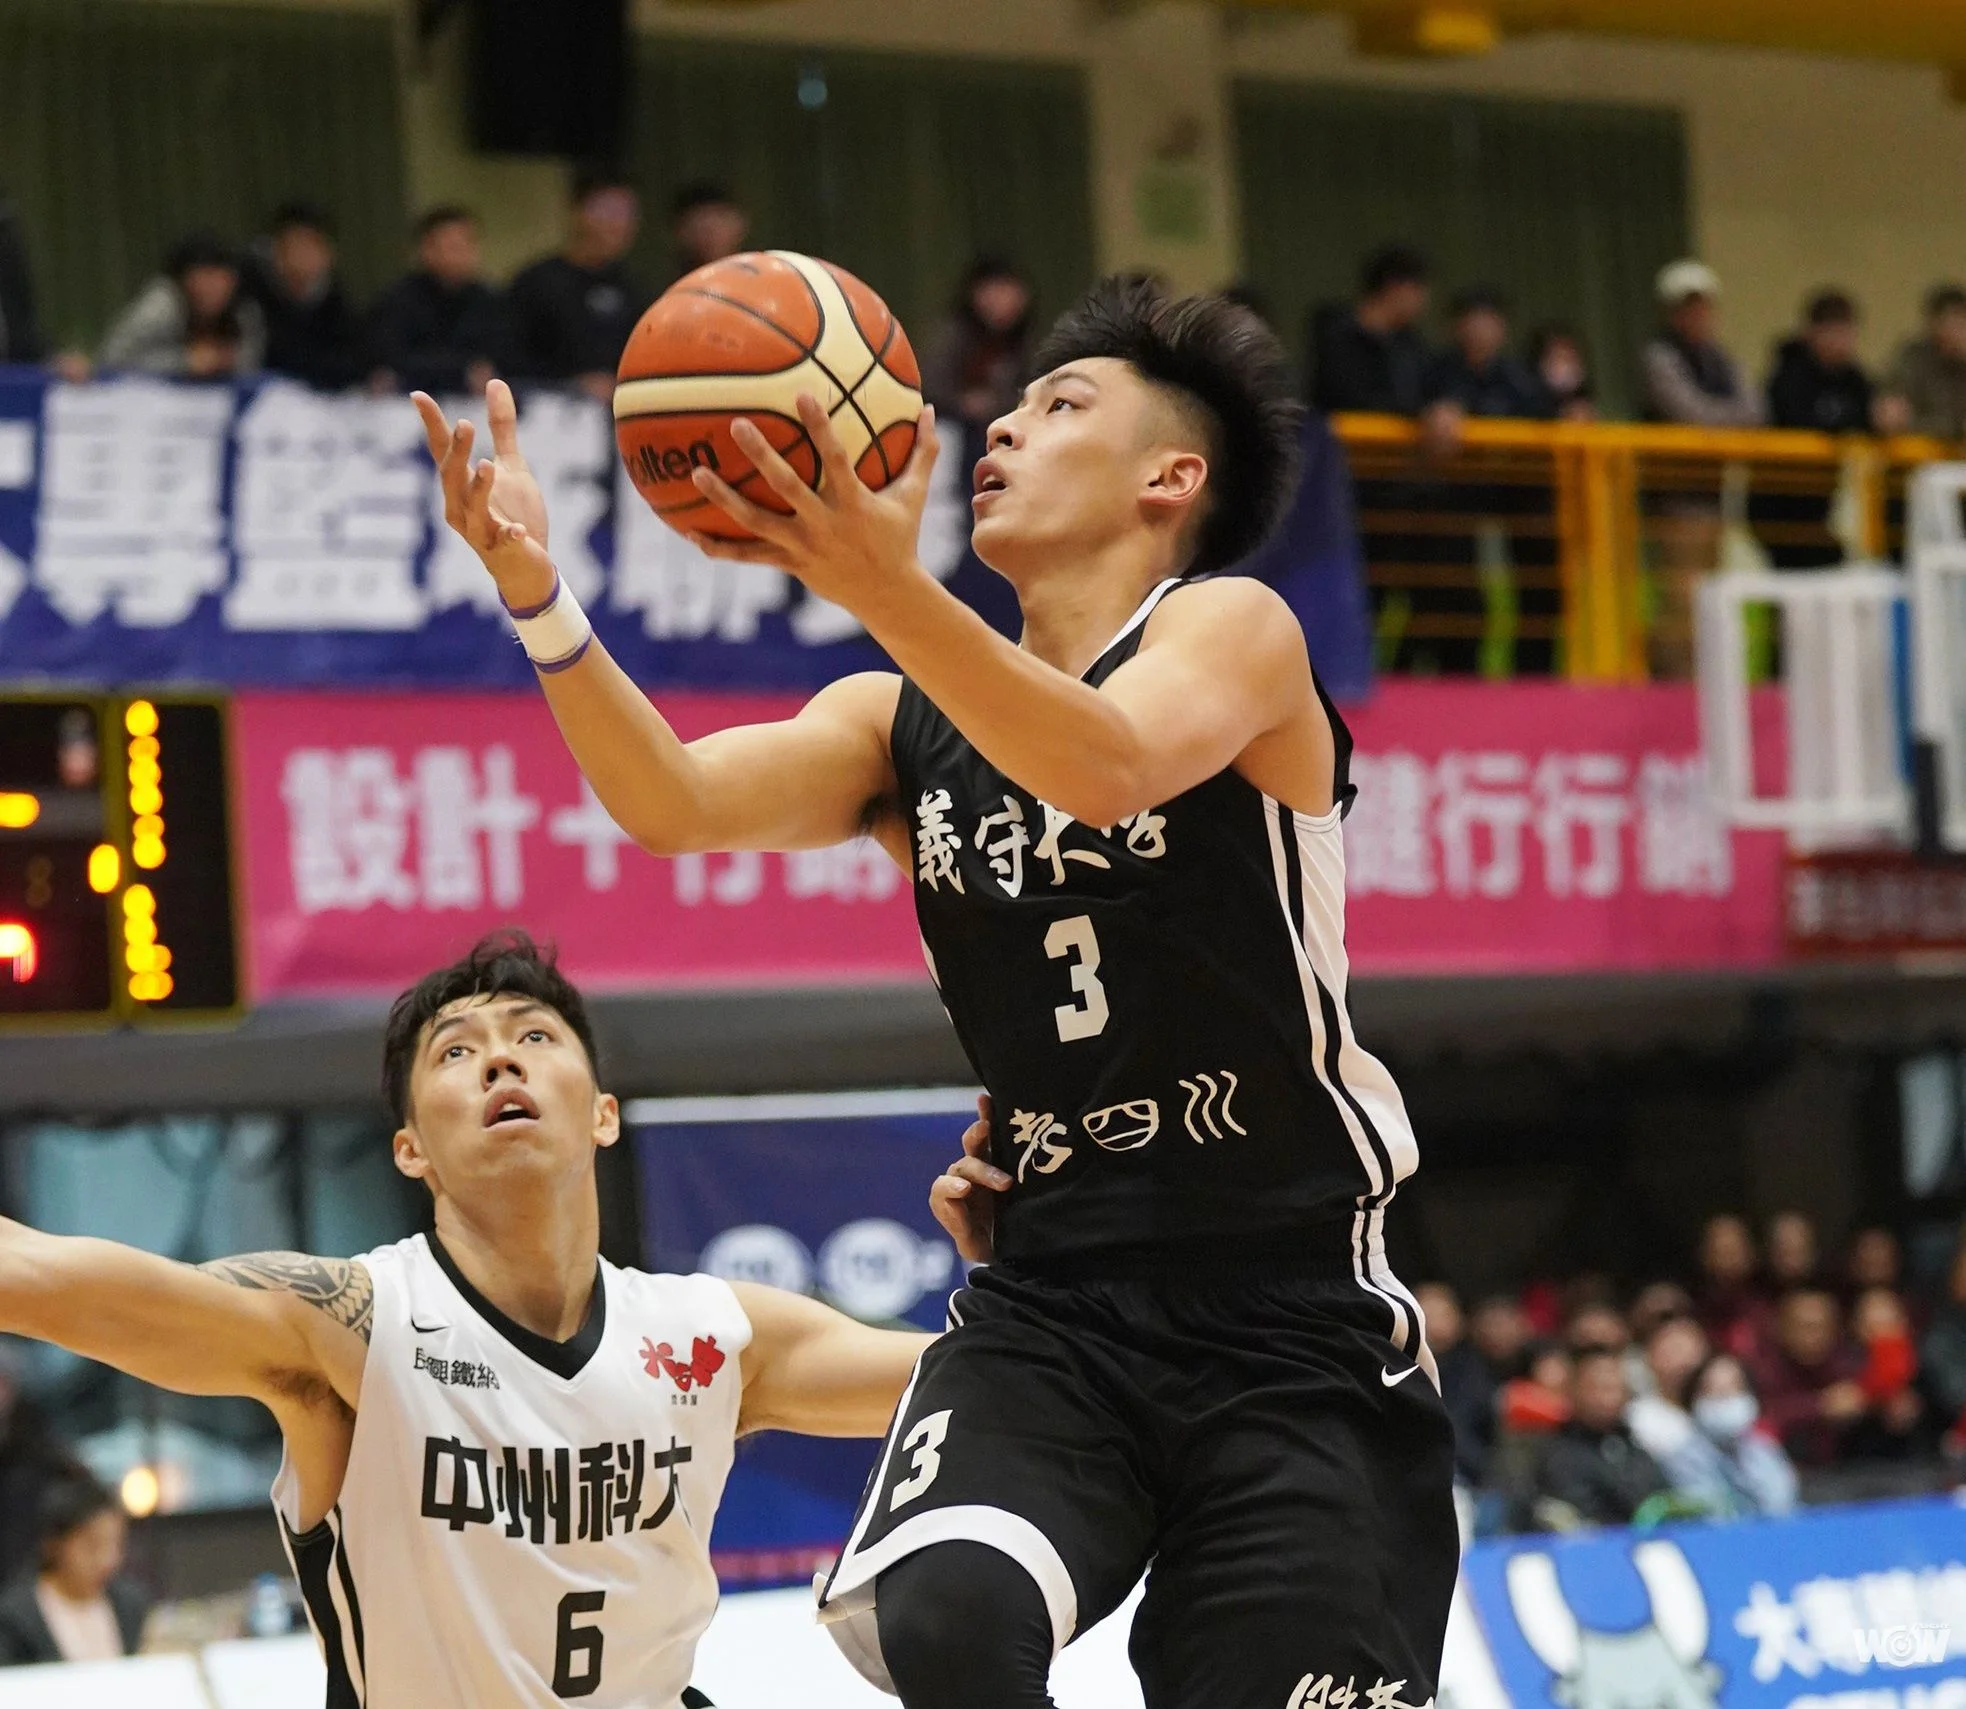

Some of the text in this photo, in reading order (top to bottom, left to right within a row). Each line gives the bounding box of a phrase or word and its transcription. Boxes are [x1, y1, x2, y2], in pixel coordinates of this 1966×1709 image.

[625, 441, 721, 486] olten
[1043, 914, 1110, 1043] 3
[421, 1435, 692, 1545] 中州科大
[889, 1408, 954, 1512] 3
[552, 1590, 606, 1699] 6
